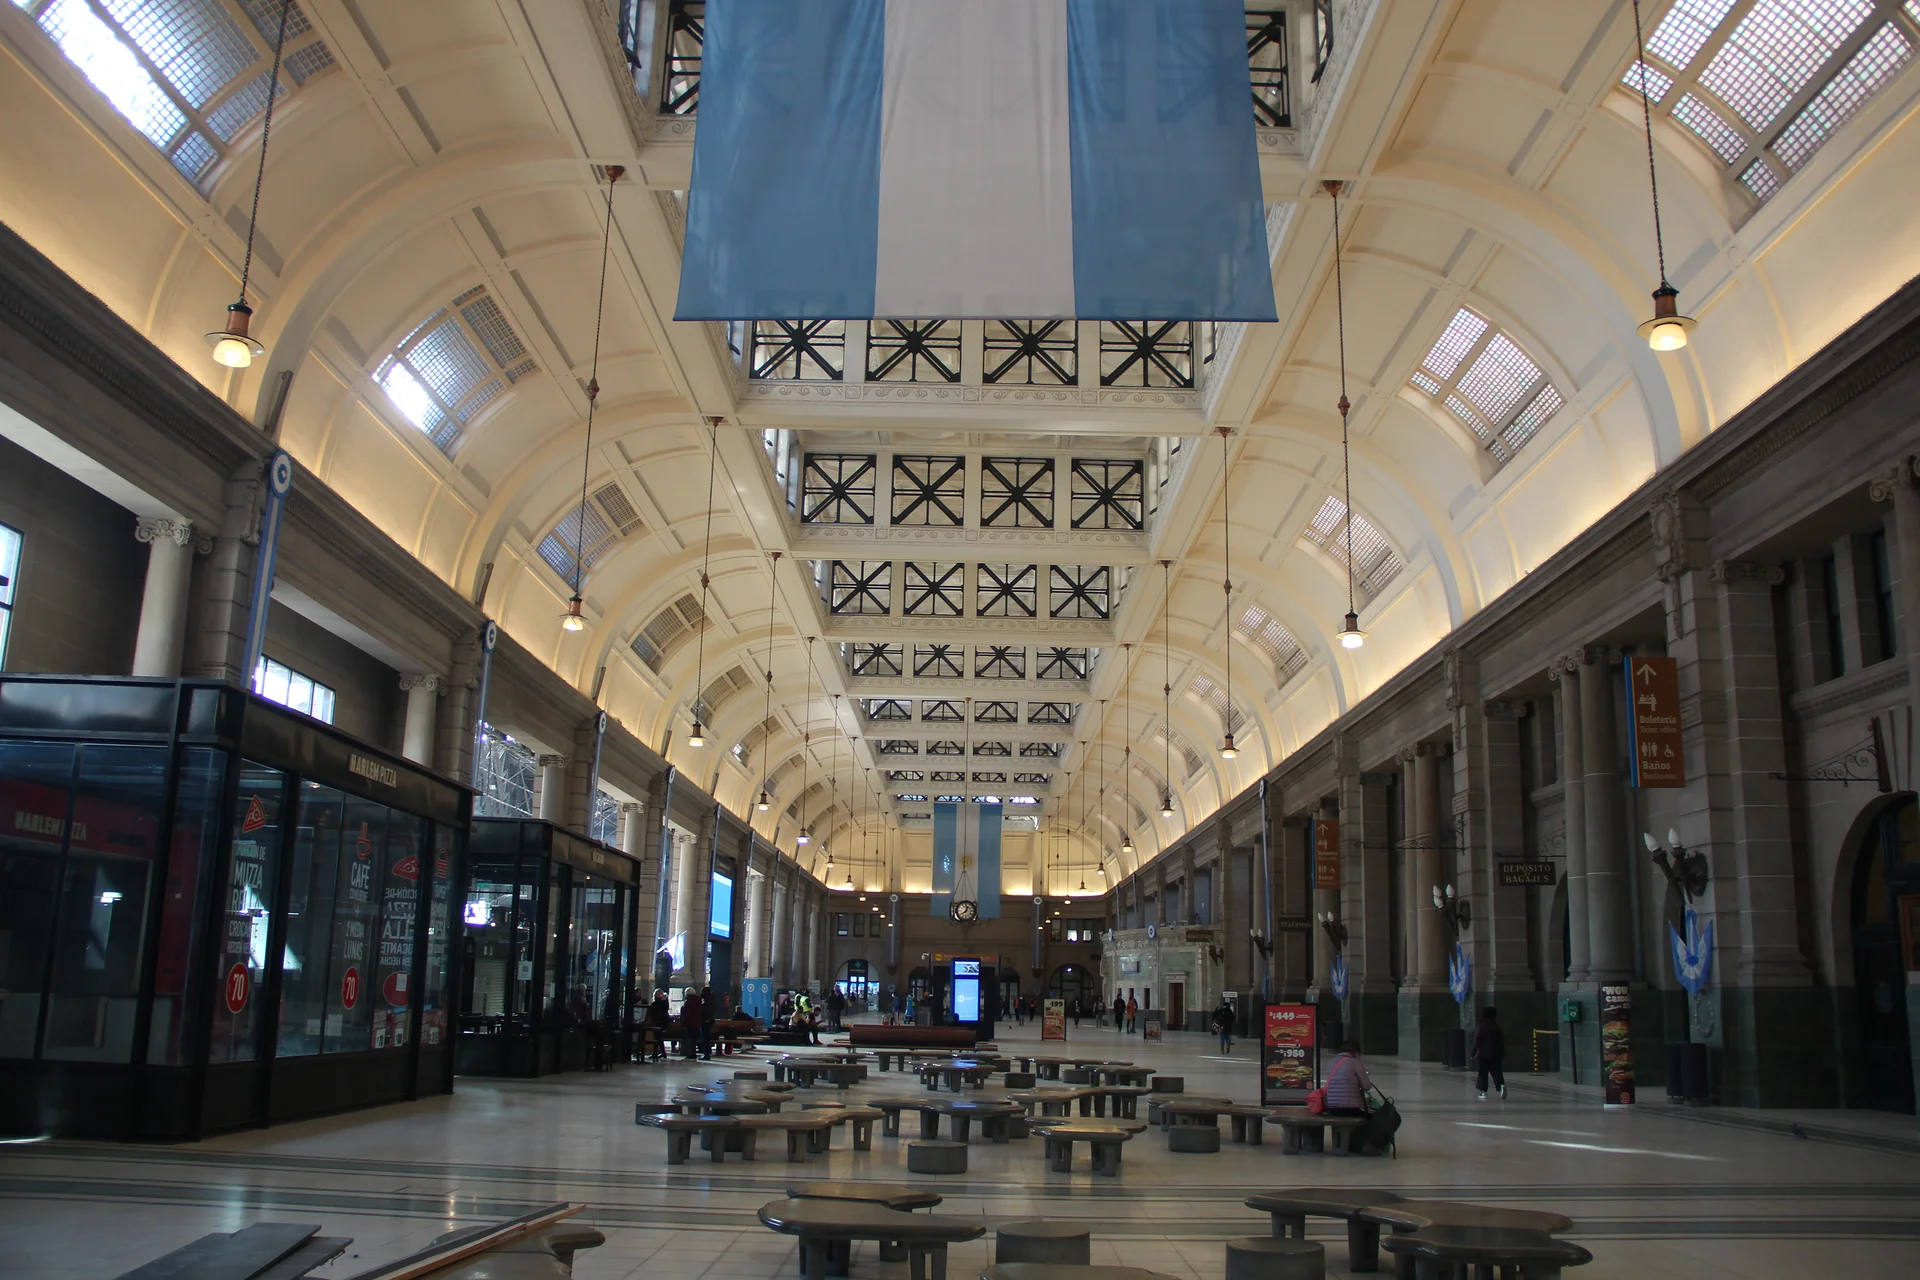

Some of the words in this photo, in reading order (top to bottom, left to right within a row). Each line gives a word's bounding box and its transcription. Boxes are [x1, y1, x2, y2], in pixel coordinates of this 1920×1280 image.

[348, 753, 379, 782] HARLEM
[379, 765, 397, 788] PIZZA
[1642, 760, 1671, 769] Baños
[14, 811, 61, 836] HARLEM
[234, 860, 263, 889] MUZZA
[350, 860, 371, 889] CAFÉ
[1503, 862, 1551, 872] DEPÓSITO
[1505, 874, 1550, 883] BAGAJES
[343, 939, 364, 960] LUNAS
[232, 973, 244, 1000] 70
[345, 976, 356, 1000] 70
